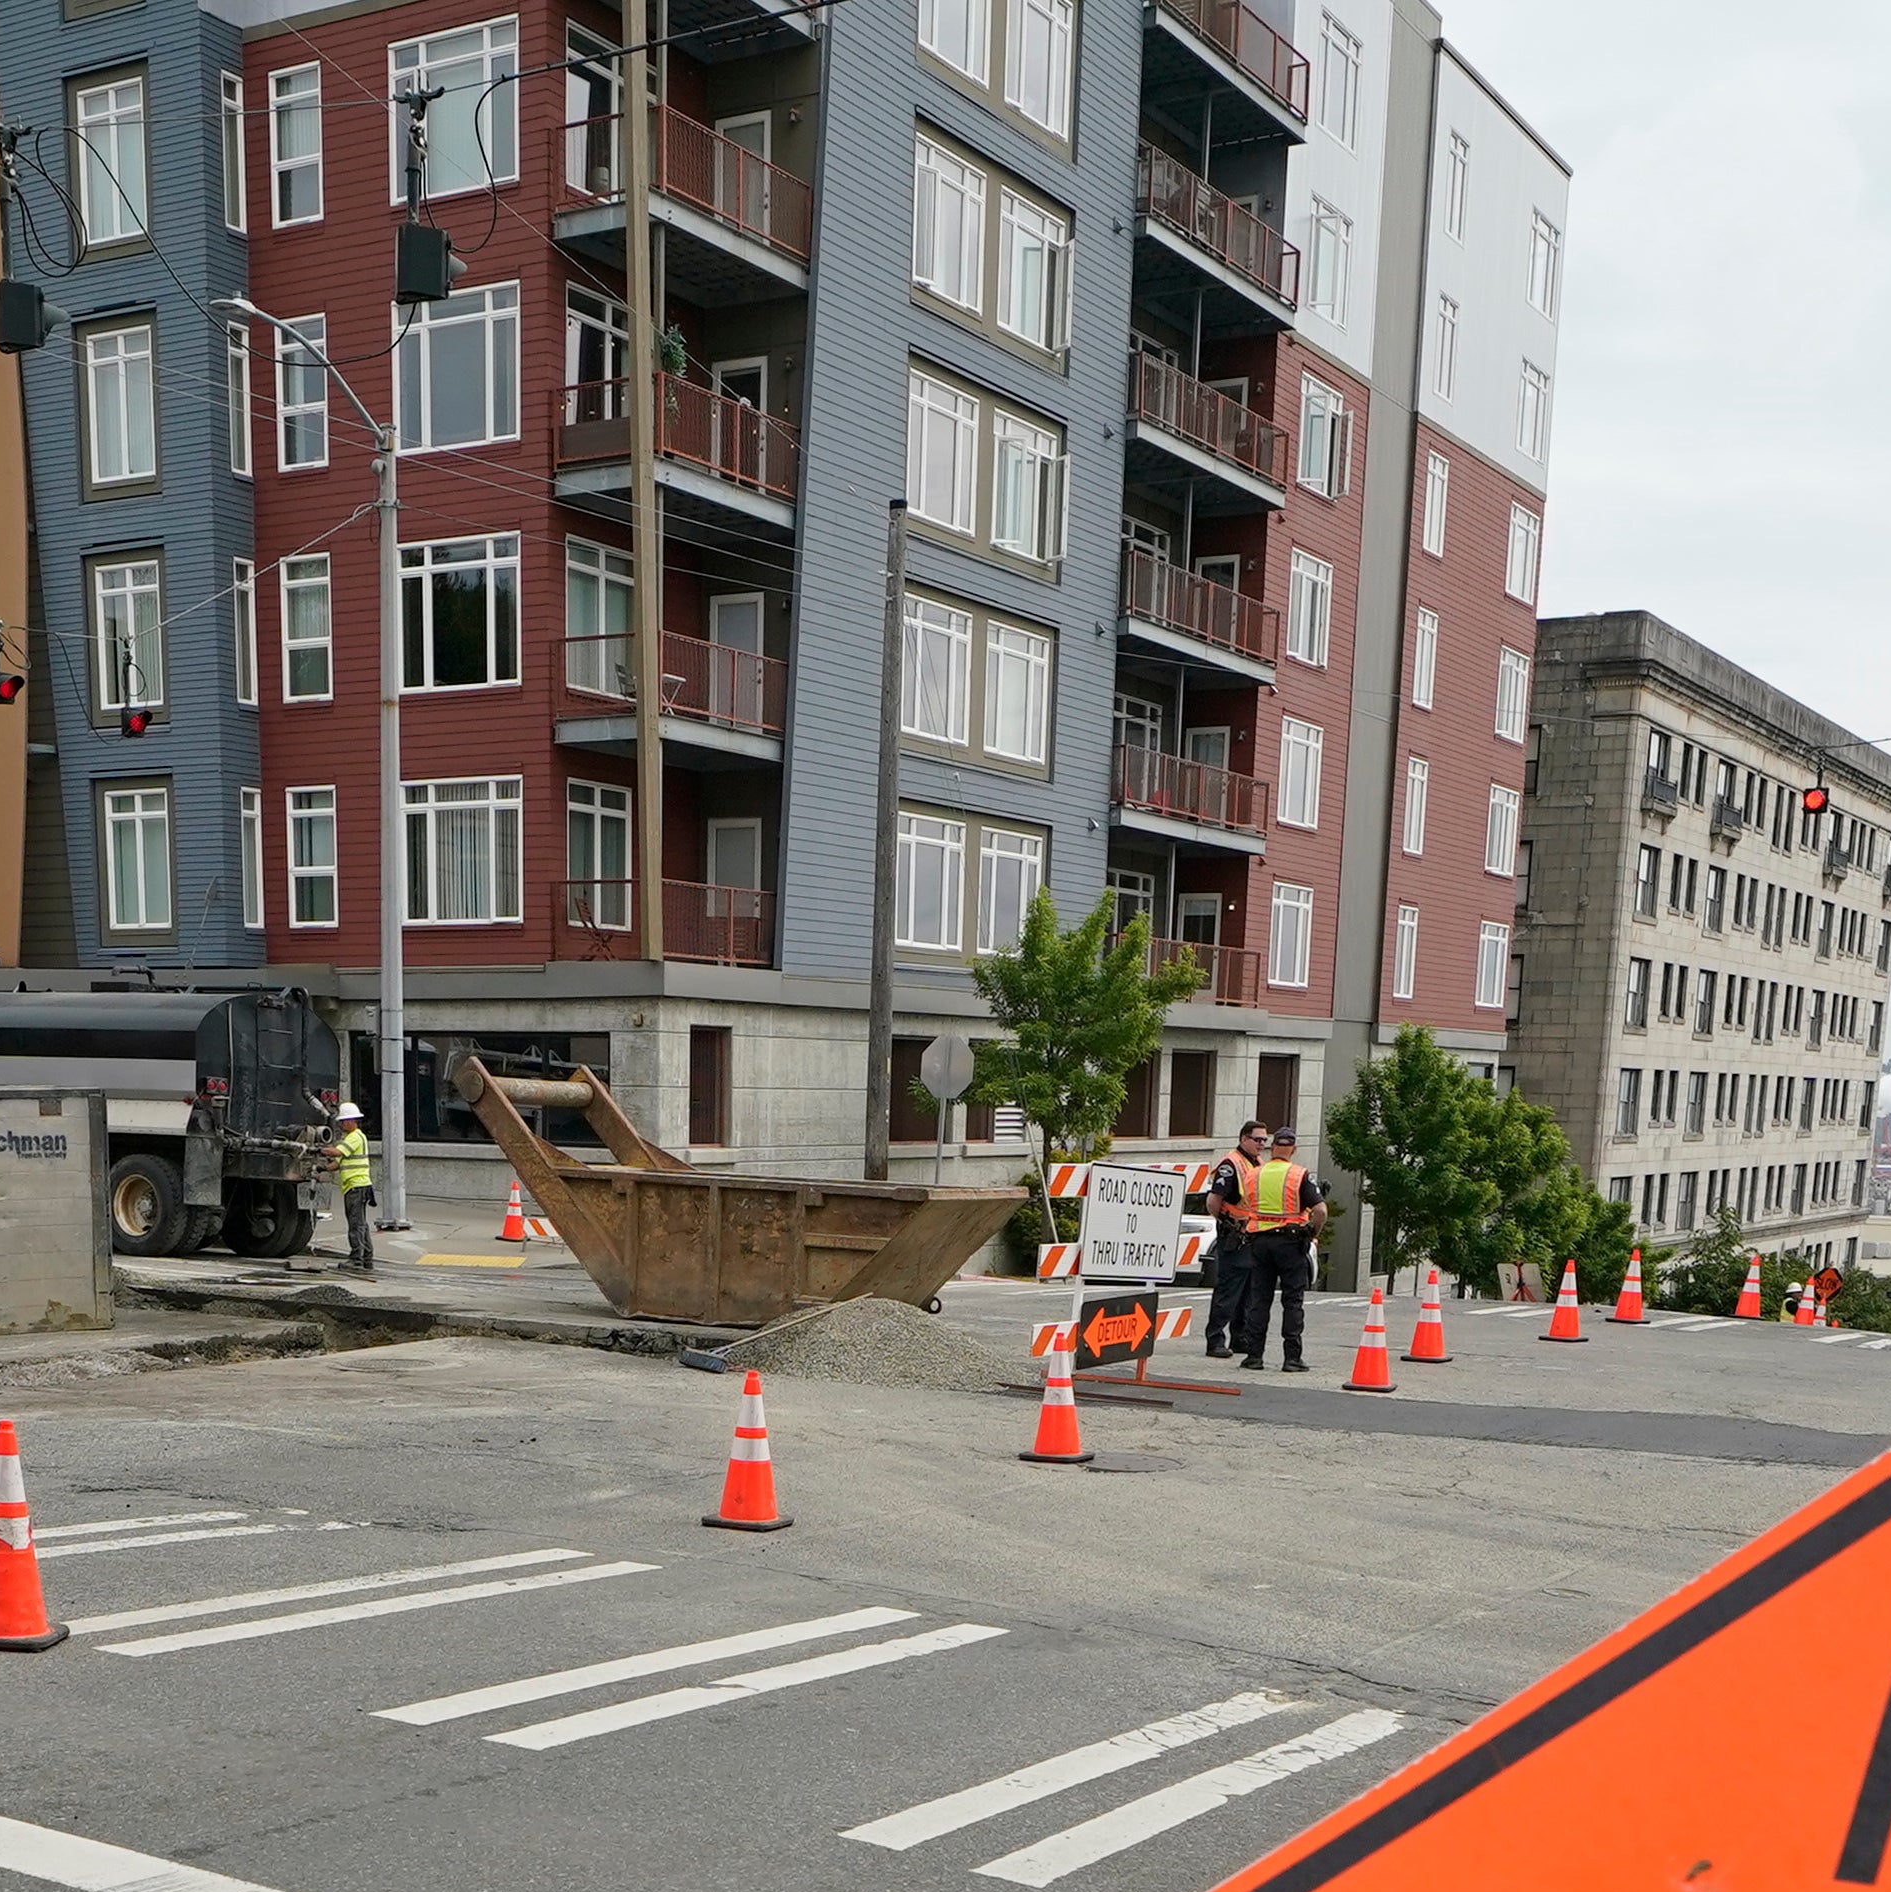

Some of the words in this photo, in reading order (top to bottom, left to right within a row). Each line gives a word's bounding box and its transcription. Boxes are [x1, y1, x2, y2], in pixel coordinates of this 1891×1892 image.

[1098, 1178, 1127, 1204] ROAD
[1130, 1181, 1173, 1208] CLOSED
[1126, 1213, 1137, 1233] TO
[1092, 1240, 1119, 1265] THRU
[1122, 1242, 1166, 1268] TRAFFIC
[1815, 1278, 1839, 1290] SLOW
[1097, 1317, 1137, 1343] DETOUR
